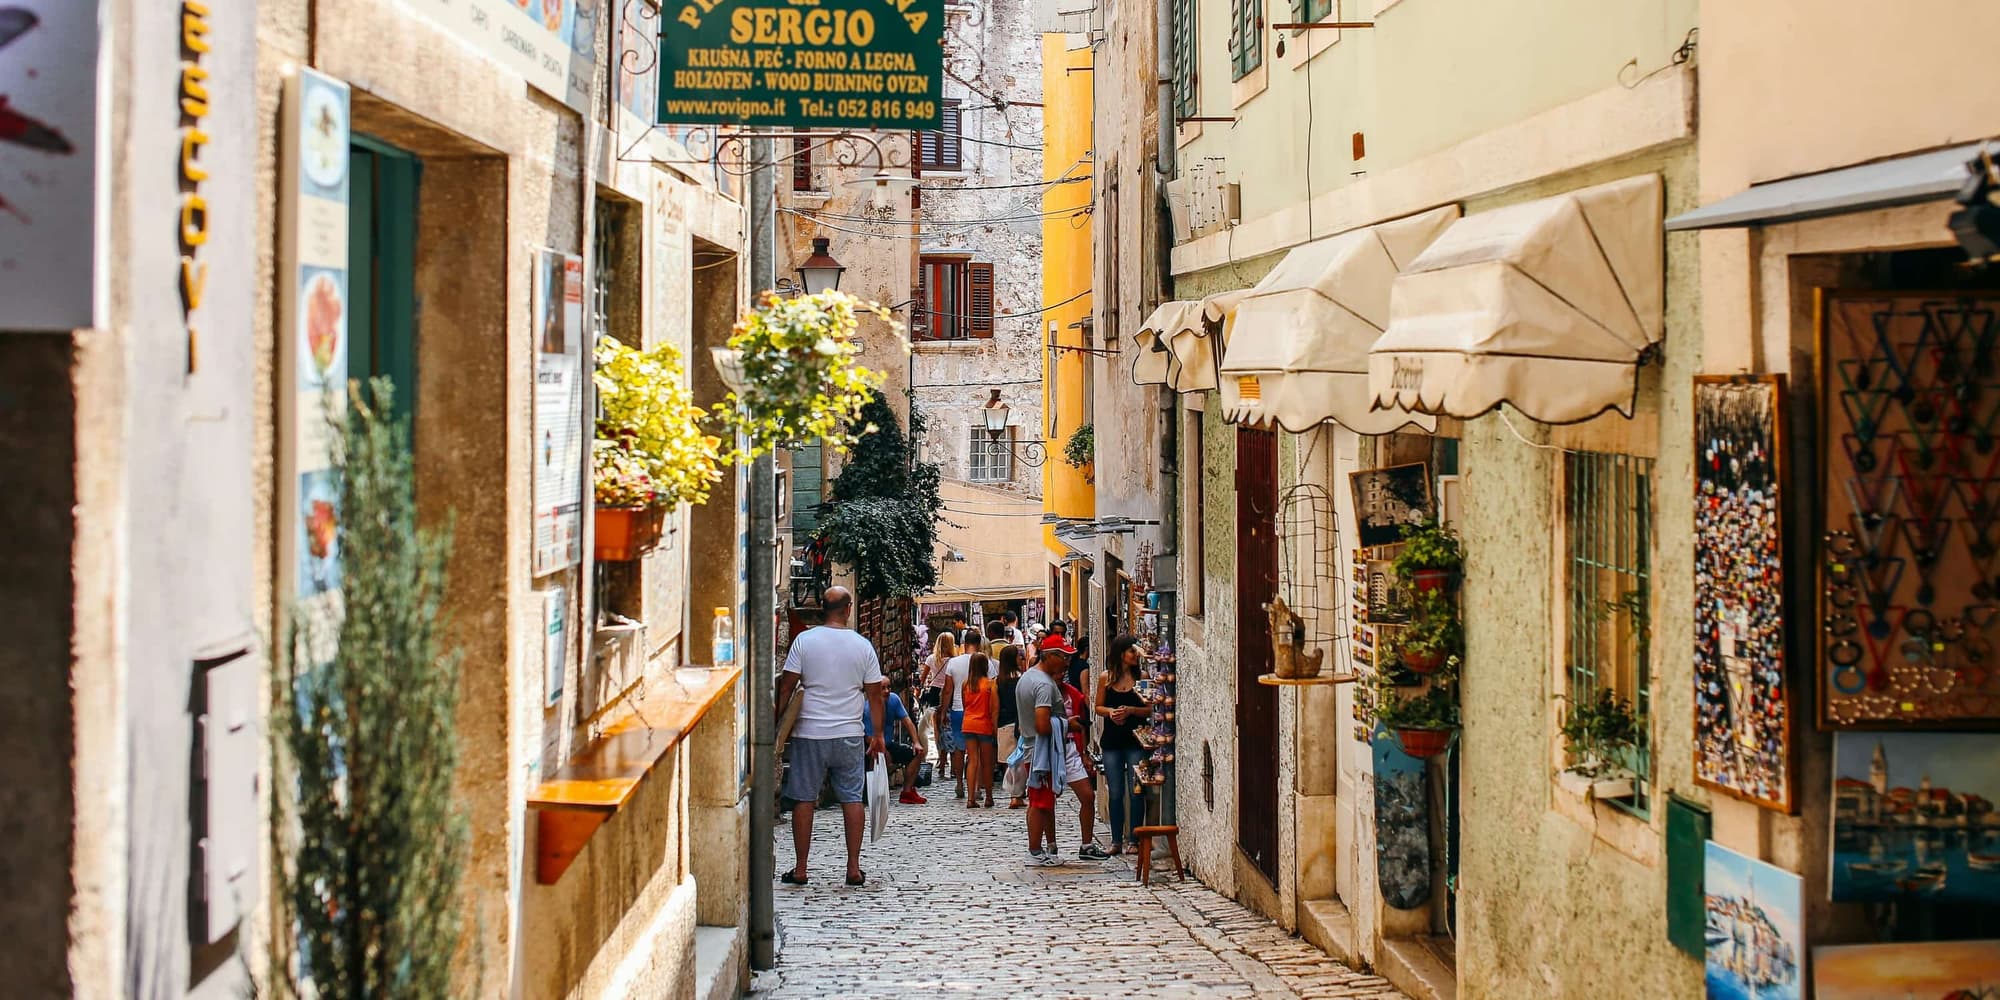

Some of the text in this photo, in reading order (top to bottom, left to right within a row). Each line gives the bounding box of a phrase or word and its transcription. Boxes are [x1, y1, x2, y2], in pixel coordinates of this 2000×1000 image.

[730, 7, 875, 46] SERGIO
[687, 44, 751, 67] KRUŠNA
[795, 51, 847, 70] FORNO
[850, 52, 861, 70] A
[865, 52, 916, 71] LEGNA
[674, 71, 753, 89] HOLZOFEN
[764, 72, 810, 91] WOOD
[813, 73, 883, 92] BURNING
[887, 75, 928, 93] OVEN
[667, 97, 935, 119] www.rovigno.it Tel.: 052 816 949
